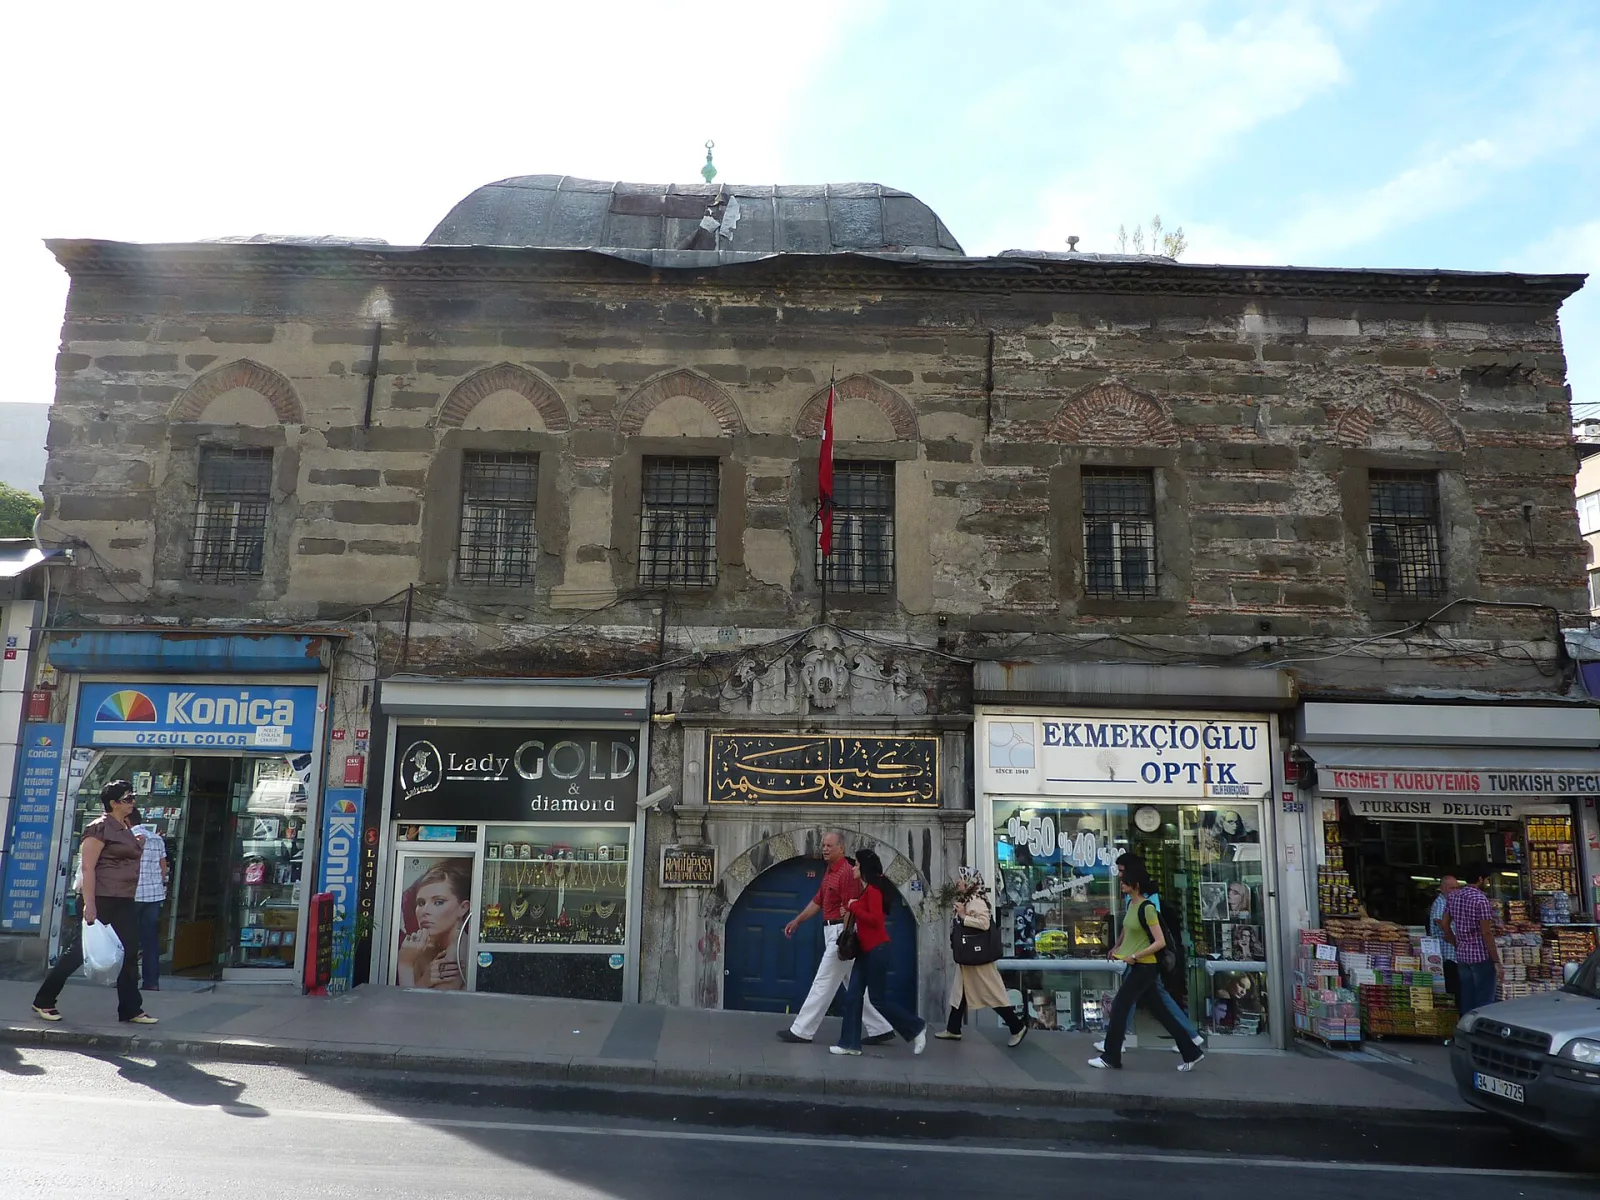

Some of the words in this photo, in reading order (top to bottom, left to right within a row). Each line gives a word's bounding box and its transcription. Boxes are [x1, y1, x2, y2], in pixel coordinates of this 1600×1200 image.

[165, 691, 295, 726] Konica
[136, 731, 188, 744] ÖZGÜL
[194, 734, 247, 745] COLOR
[1042, 719, 1257, 755] EKMEKÇİOĞLU
[27, 749, 58, 758] Konica
[447, 752, 510, 777] Lady
[513, 740, 636, 780] GOLD
[1141, 756, 1239, 785] OPTİK
[1334, 772, 1388, 789] KISMET
[1393, 771, 1480, 793] KURUYEMİŞ
[1488, 774, 1553, 792] TURKISH
[531, 795, 616, 812] diamond
[568, 783, 580, 795] &
[1360, 800, 1431, 814] TURKISH
[1442, 803, 1513, 817] DELIGHT
[1008, 816, 1055, 857] %50
[1058, 832, 1096, 867] %40
[365, 849, 376, 890] Lady
[361, 898, 372, 938] God
[1478, 1075, 1488, 1089] 34
[1491, 1079, 1496, 1092] J
[1503, 1082, 1524, 1101] 2725
